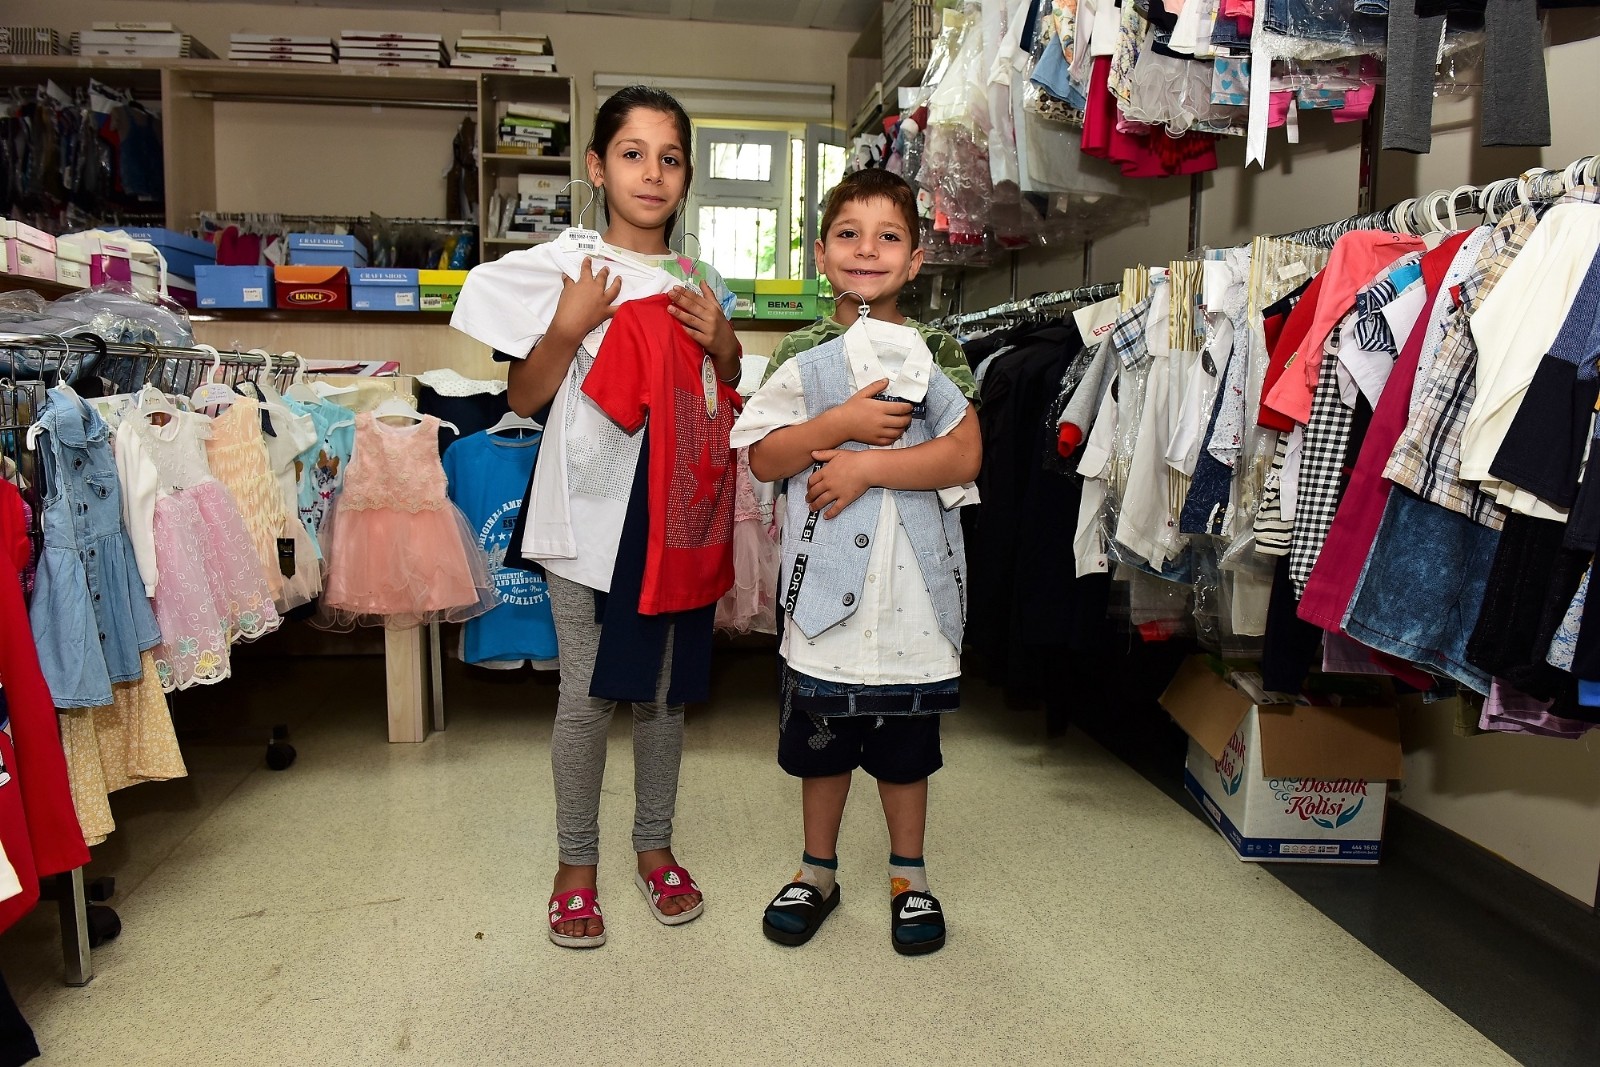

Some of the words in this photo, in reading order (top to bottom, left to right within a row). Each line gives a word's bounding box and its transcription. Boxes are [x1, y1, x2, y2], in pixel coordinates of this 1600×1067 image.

[767, 301, 803, 309] BEMSA
[502, 499, 522, 512] AME
[806, 511, 818, 526] HE
[496, 579, 510, 587] AND
[790, 564, 803, 591] FOR
[503, 594, 543, 605] QUALITY
[786, 594, 796, 613] YO
[1294, 777, 1368, 796] Dostluk
[1284, 794, 1346, 820] Kolisi
[783, 887, 813, 902] NIKE
[905, 896, 934, 911] NIKE
